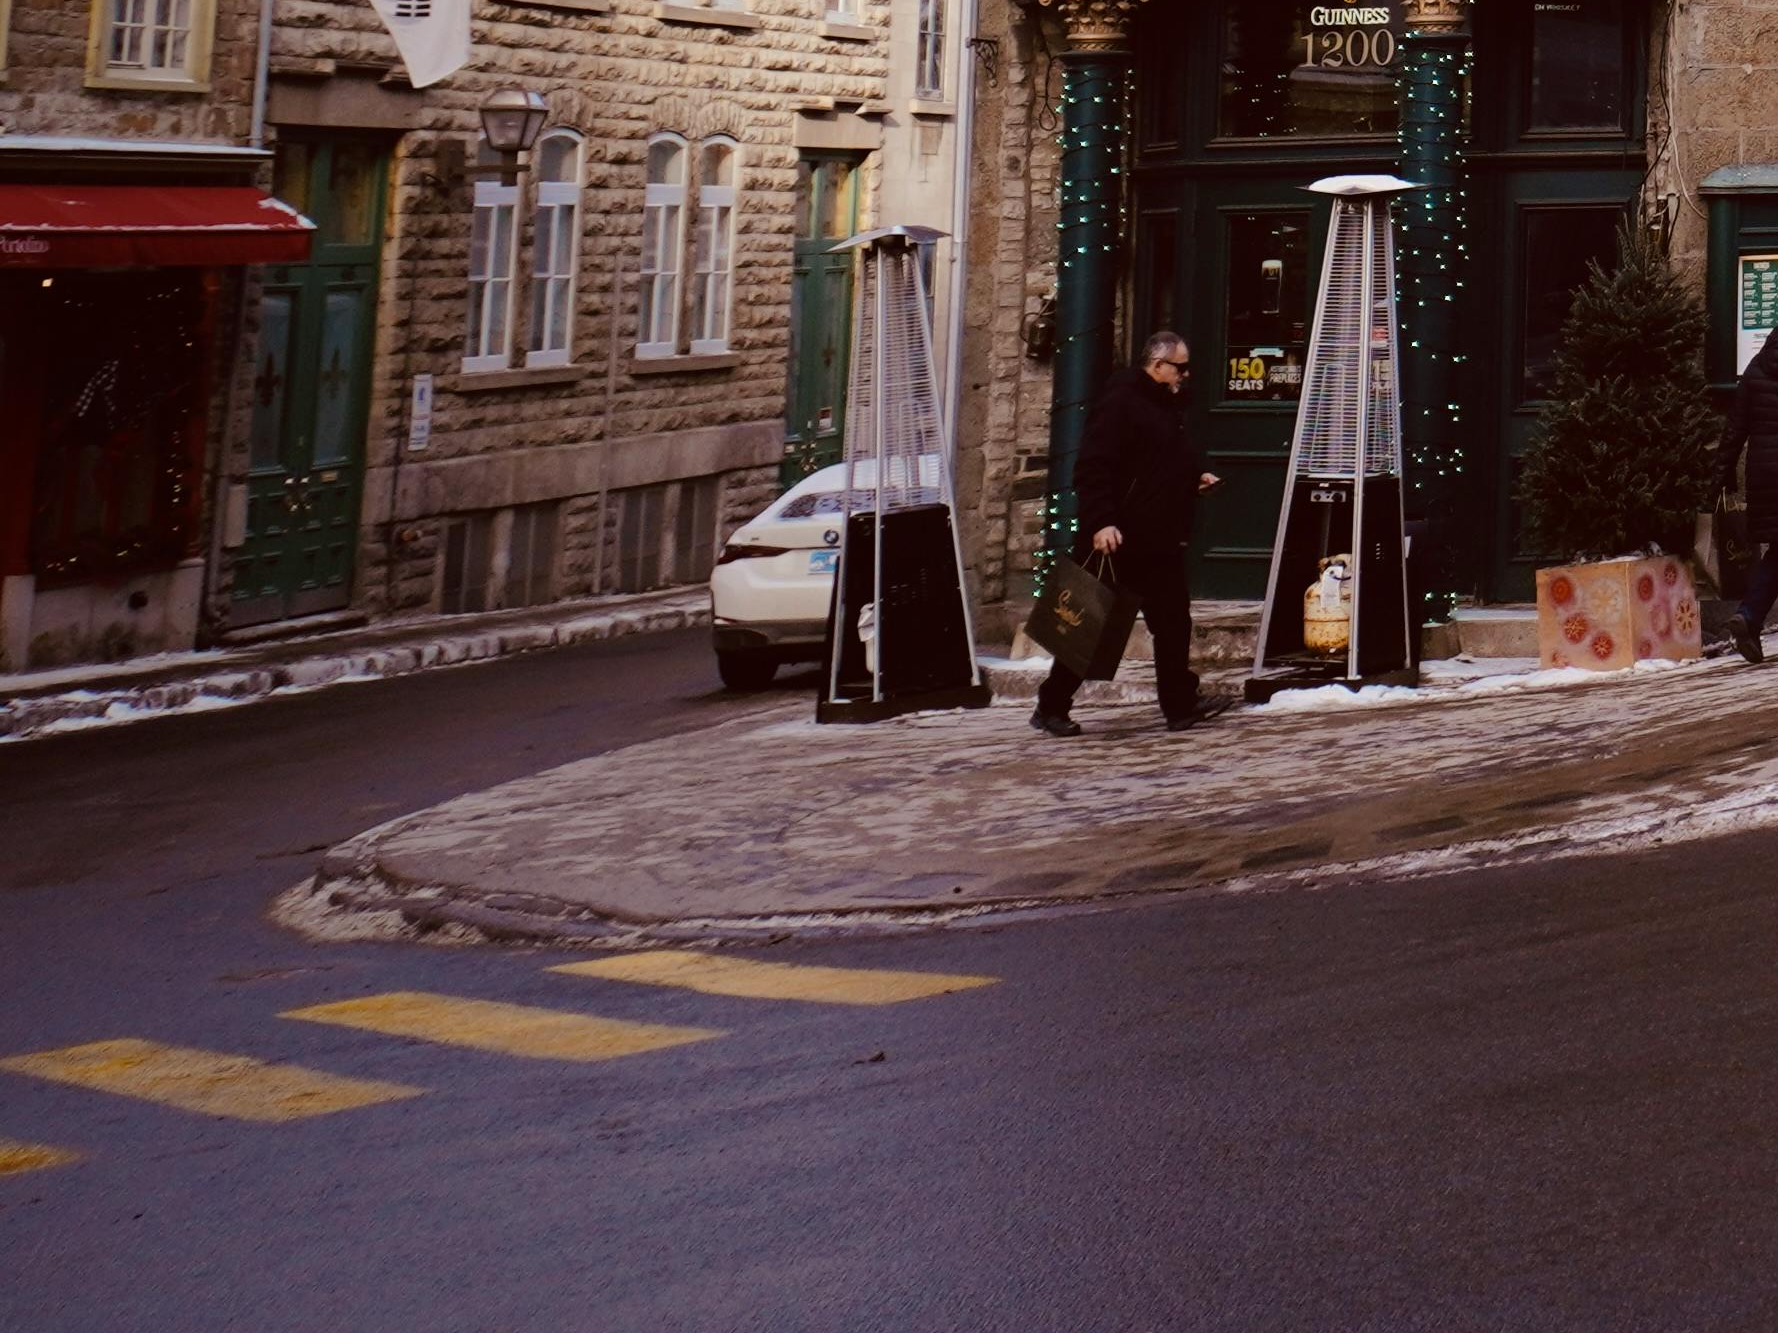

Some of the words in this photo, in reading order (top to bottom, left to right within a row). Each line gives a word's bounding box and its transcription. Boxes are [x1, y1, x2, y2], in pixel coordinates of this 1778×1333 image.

[1300, 28, 1395, 69] 1200
[1229, 357, 1266, 380] 150
[1228, 379, 1265, 391] SEATS
